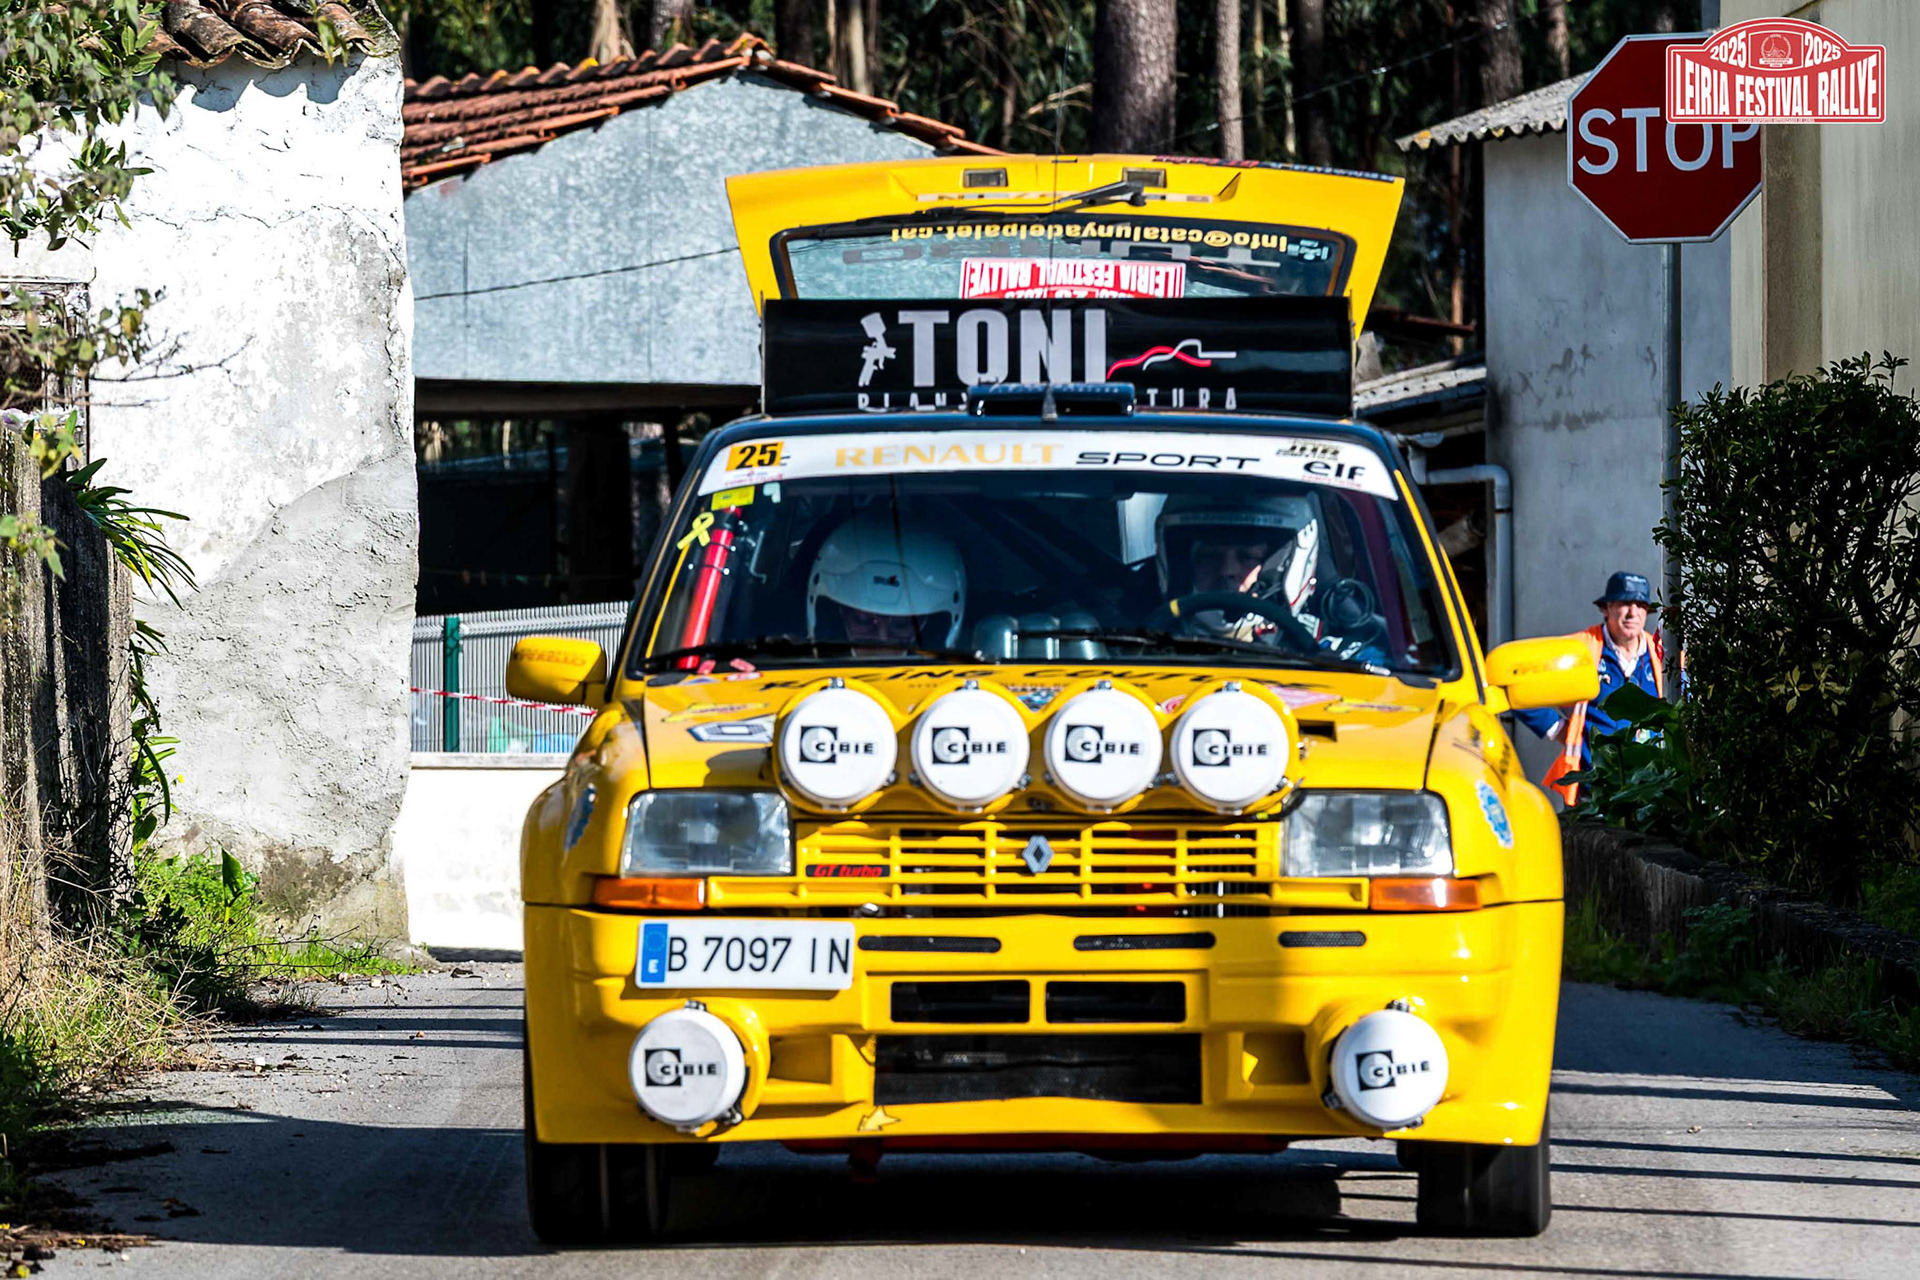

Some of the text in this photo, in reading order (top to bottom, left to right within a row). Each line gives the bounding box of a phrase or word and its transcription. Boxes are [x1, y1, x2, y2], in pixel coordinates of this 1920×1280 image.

[1577, 107, 1760, 175] STOP
[898, 308, 1106, 387] TONI
[735, 443, 778, 470] 25
[834, 443, 1064, 468] RENAULT
[1075, 450, 1261, 470] SPORT
[1303, 461, 1366, 480] elf
[815, 742, 874, 755] CIBIE
[947, 741, 1007, 754] CIBIE
[1080, 741, 1140, 755] CIBIE
[1208, 744, 1268, 756] CIBIE
[813, 864, 883, 878] GT turbo
[667, 936, 688, 972] B
[702, 936, 793, 973] 7097
[648, 958, 659, 974] E
[659, 1063, 719, 1076] CIBIE
[1373, 1060, 1431, 1077] CIBIE
